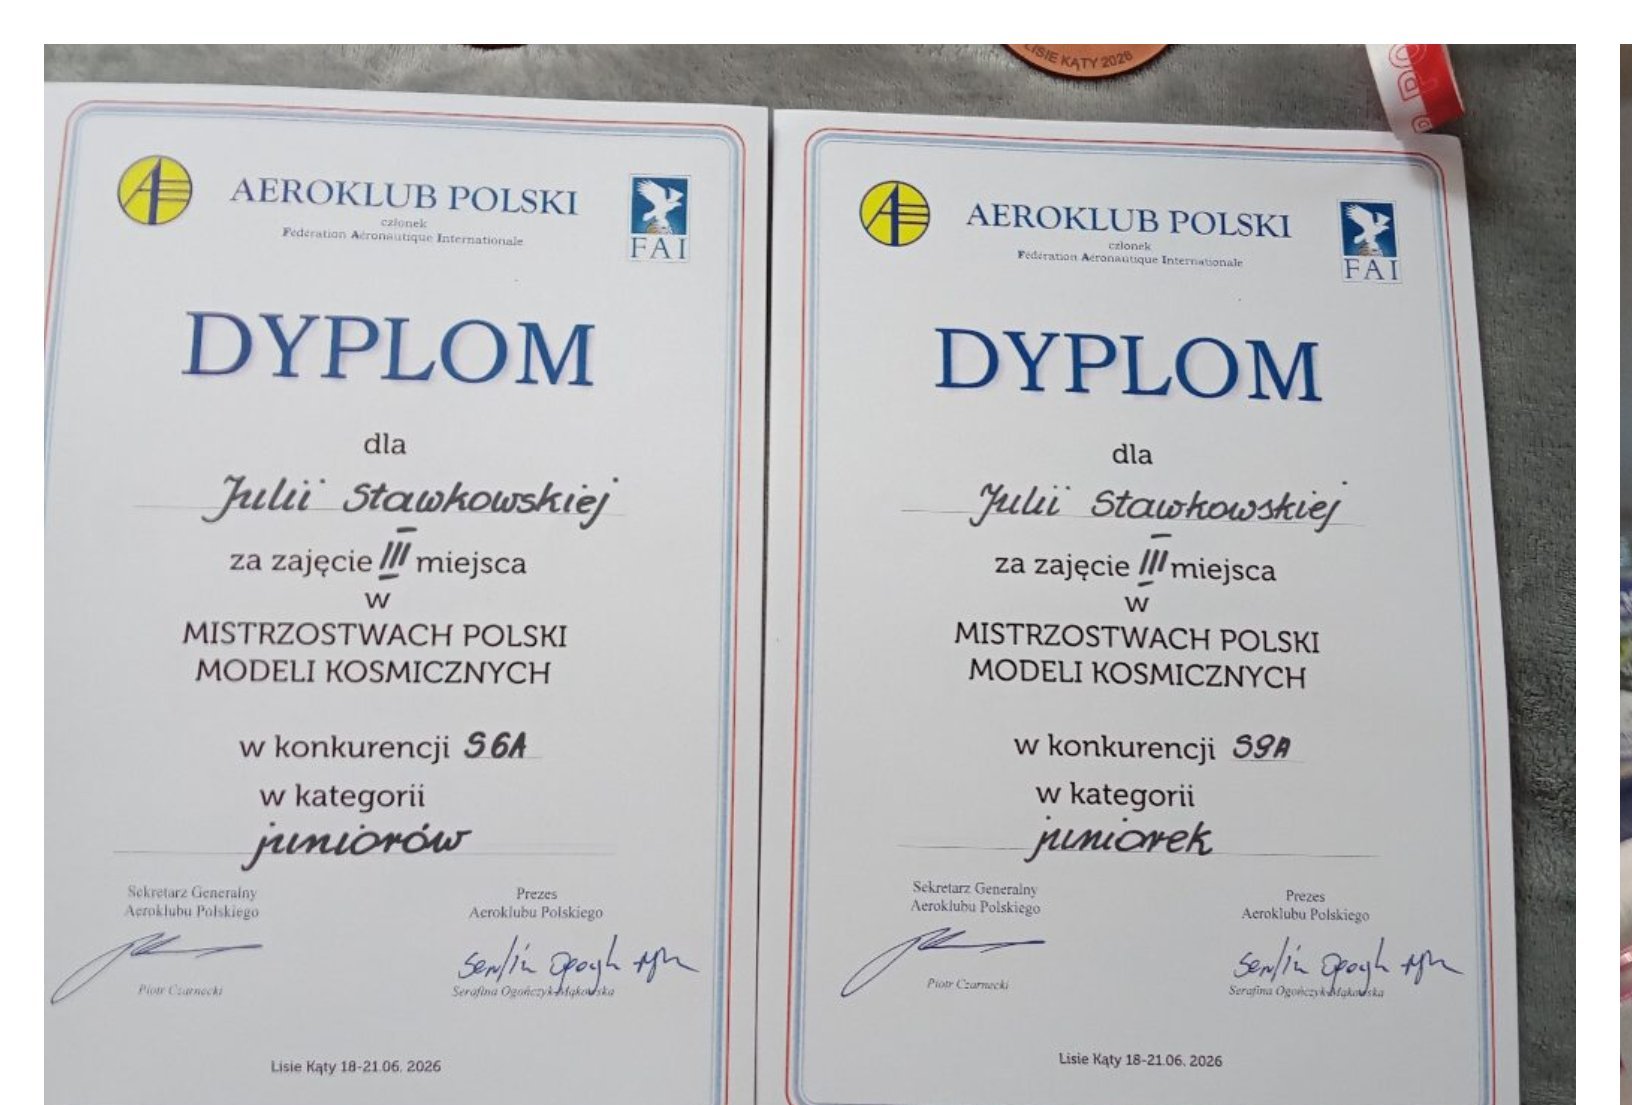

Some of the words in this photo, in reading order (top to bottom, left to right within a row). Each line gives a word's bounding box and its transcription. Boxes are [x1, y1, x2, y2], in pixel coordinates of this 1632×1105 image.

[230, 178, 437, 208] AEROKLUB
[448, 185, 578, 215] POLSKI
[966, 203, 1159, 232] AEROKLUB
[1168, 210, 1292, 238] POLSKI
[437, 233, 523, 247] Internationale
[631, 237, 685, 259] FAI
[1162, 255, 1243, 267] Internationale
[1344, 256, 1398, 280] FAI
[181, 311, 595, 386] DYPLOM
[935, 328, 1323, 403] DYPLOM
[364, 432, 407, 455] dla
[1112, 443, 1153, 465] dla
[230, 553, 262, 571] za
[271, 549, 372, 578] zajęcie
[416, 551, 527, 580] miejsca
[995, 557, 1026, 574] za
[1034, 553, 1130, 582] zajęcie
[1170, 557, 1277, 586] miejsca
[364, 592, 391, 609] w
[1124, 596, 1150, 612] w
[182, 621, 453, 647] MISTRZOSTWACH
[463, 624, 567, 648] POLSKI
[954, 621, 1211, 651] MISTRZOSTWACH
[1220, 629, 1320, 654] POLSKI
[195, 658, 316, 683] MODELI
[326, 660, 551, 684] KOSMICZNYCH
[968, 658, 1083, 683] MODELI
[1091, 661, 1306, 689] KOSMICZNYCH
[239, 740, 266, 758] w
[275, 734, 450, 765] konkurencji
[1014, 738, 1040, 755] w
[1048, 733, 1216, 766] konkurencji
[259, 789, 286, 807] w
[295, 783, 425, 814] kategorii
[1035, 786, 1062, 804] w
[1070, 781, 1195, 813] kategorii
[128, 885, 187, 898] Sekretarz
[191, 885, 257, 902] Generalny
[517, 887, 557, 900] Prezes
[913, 881, 971, 894] Sekretarz
[974, 882, 1038, 899] Generalny
[1286, 889, 1325, 902] Prezes
[124, 904, 192, 918] Aeroklubu
[197, 904, 260, 920] Polskiego
[469, 905, 537, 919] Aeroklubu
[542, 906, 604, 922] Polskiego
[911, 899, 976, 912] Aeroklubu
[980, 900, 1041, 917] Polskiego
[1242, 907, 1306, 920] Aeroklubu
[1311, 907, 1370, 924] Polskiego
[271, 1060, 302, 1073] Lisie
[307, 1060, 336, 1076] Kąty
[407, 1060, 441, 1073] 2026
[1059, 1052, 1089, 1065] Lisie
[1093, 1053, 1122, 1068] Kąty
[1190, 1054, 1223, 1067] 2026
